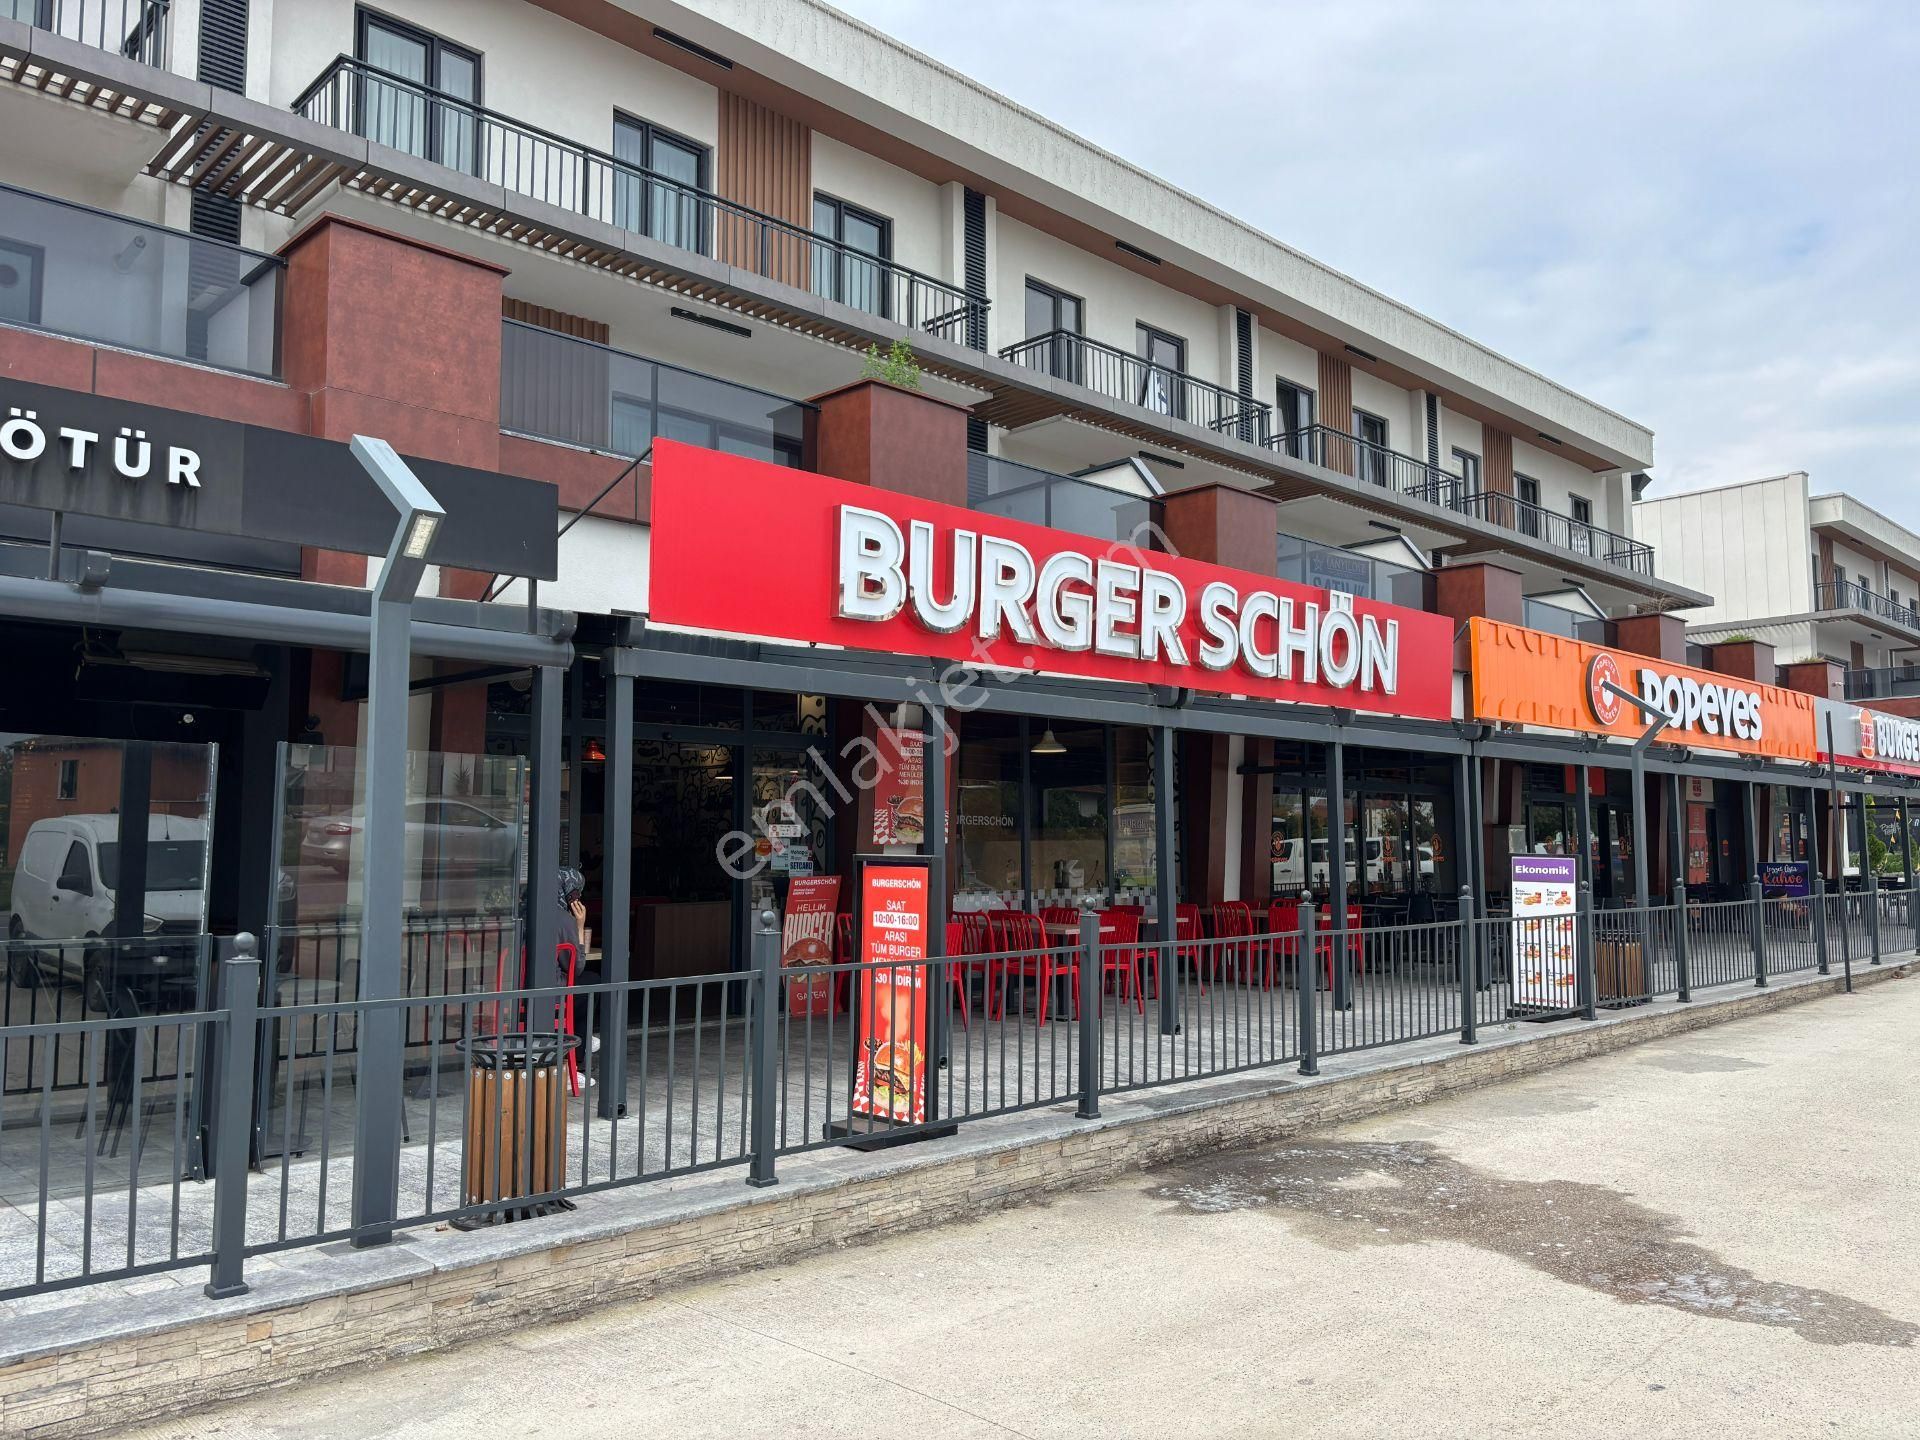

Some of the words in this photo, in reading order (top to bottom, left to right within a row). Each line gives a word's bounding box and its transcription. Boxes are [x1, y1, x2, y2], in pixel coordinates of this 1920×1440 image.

[832, 504, 1190, 667] BURGER
[1199, 581, 1398, 695] SCHÖN
[1876, 715, 1920, 762] BURGE
[790, 861, 812, 869] SETCARD
[1515, 865, 1570, 875] Ekonomik
[794, 878, 836, 886] BURGERSCHÖN
[872, 878, 921, 889] BURGERSCHÖN
[1763, 871, 1803, 884] Kahve
[886, 900, 906, 911] SAAT
[875, 913, 918, 926] 10:00-16:00
[783, 912, 835, 955] BURGER
[884, 931, 907, 942] ARASI
[871, 940, 887, 954] TÜM
[889, 944, 921, 958] BURGER
